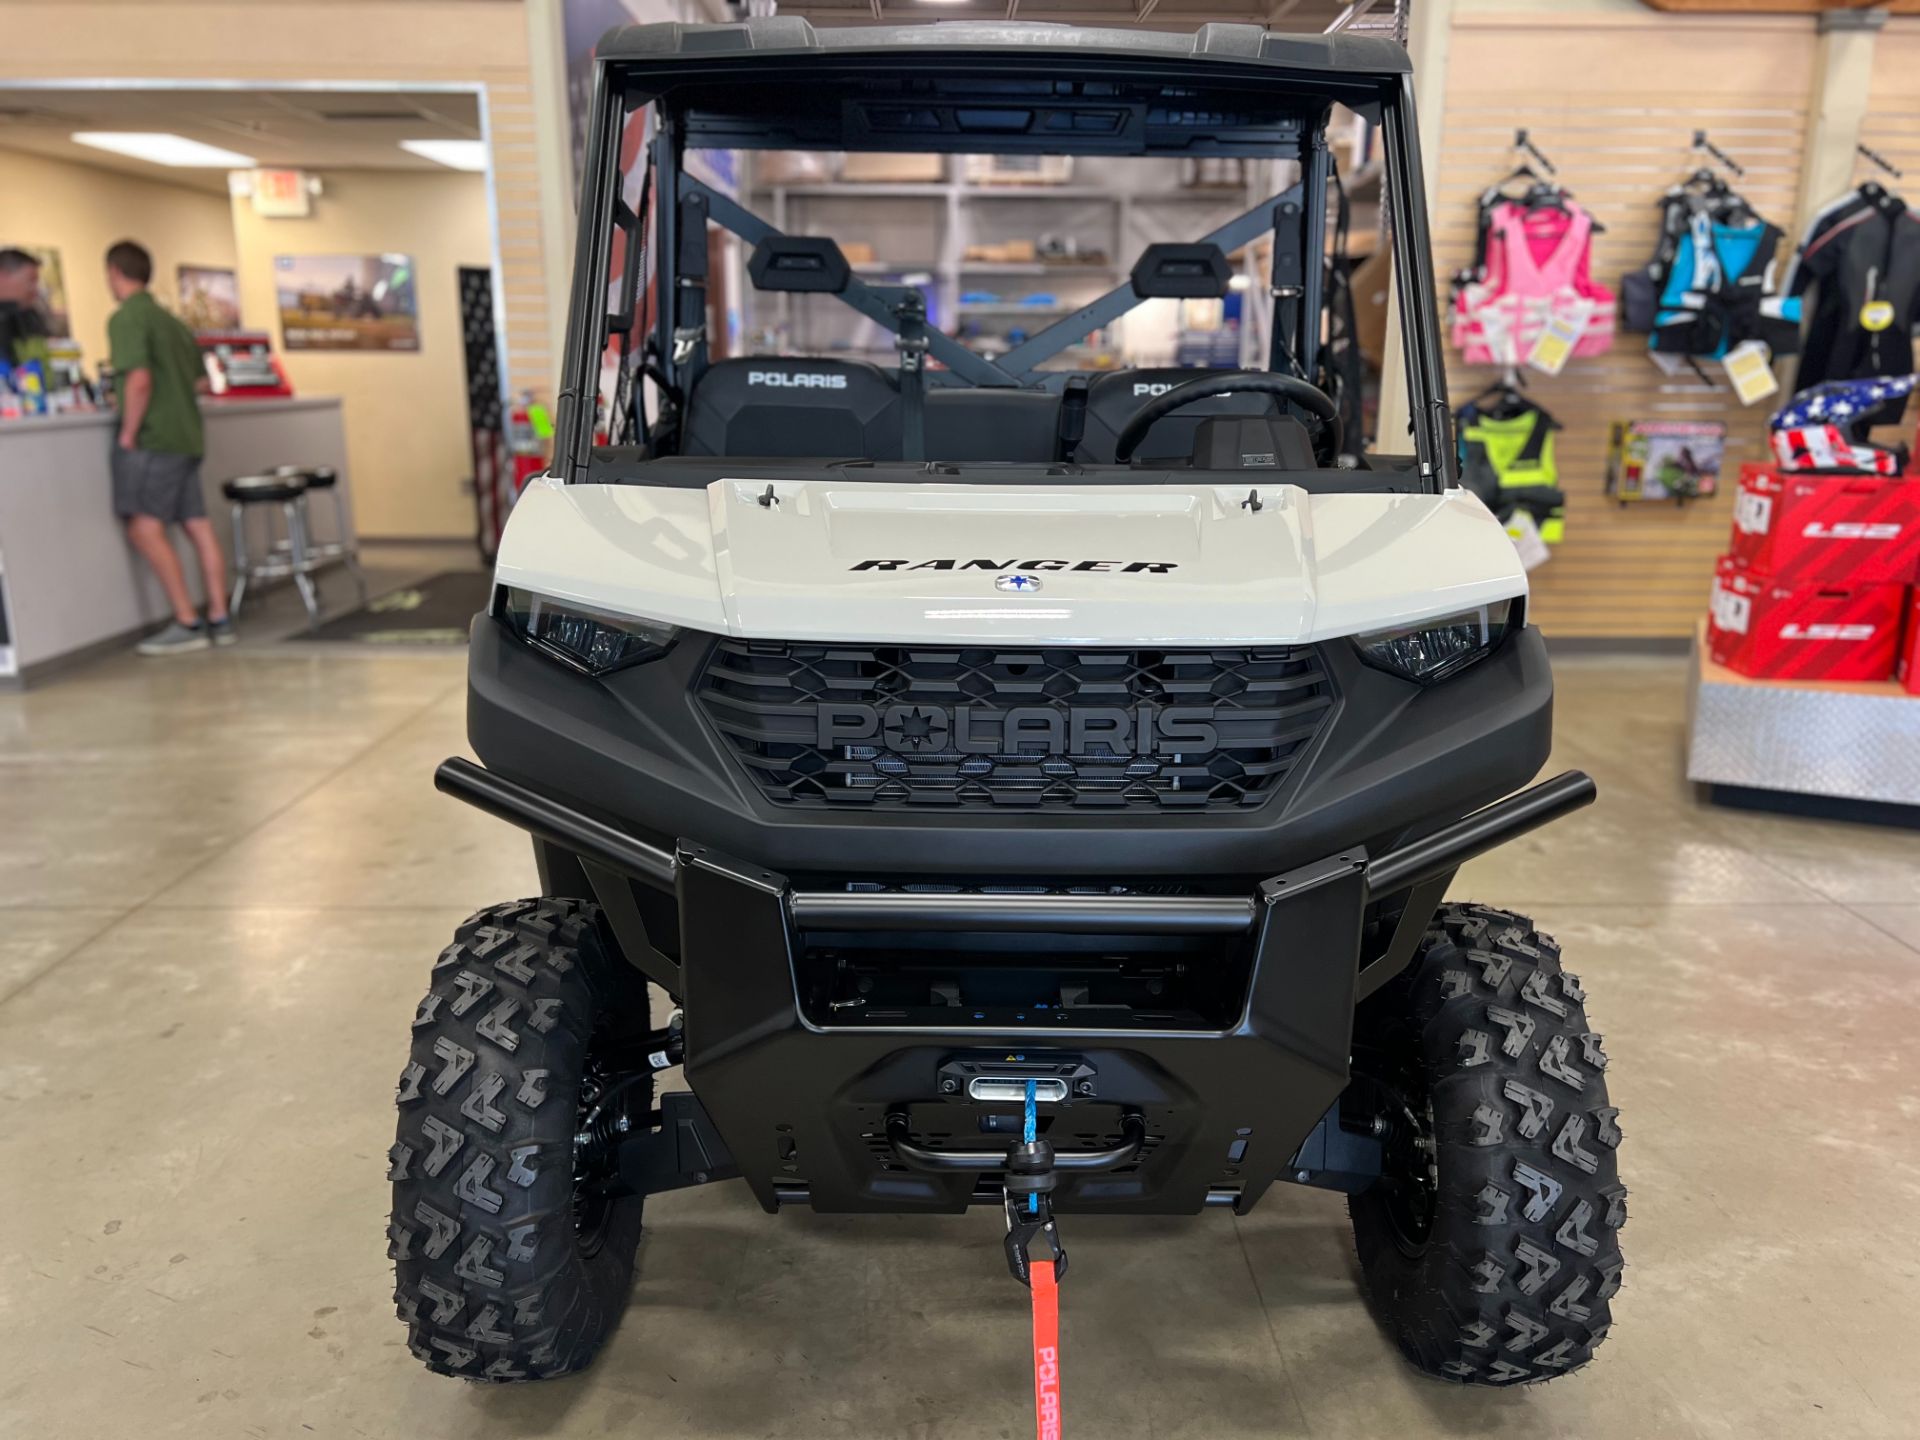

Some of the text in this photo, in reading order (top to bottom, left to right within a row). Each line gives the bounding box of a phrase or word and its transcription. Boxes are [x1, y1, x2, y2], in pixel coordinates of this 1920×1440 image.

[748, 371, 848, 389] POLARIS
[848, 559, 1179, 574] RANGER
[816, 703, 1219, 755] POLARIS
